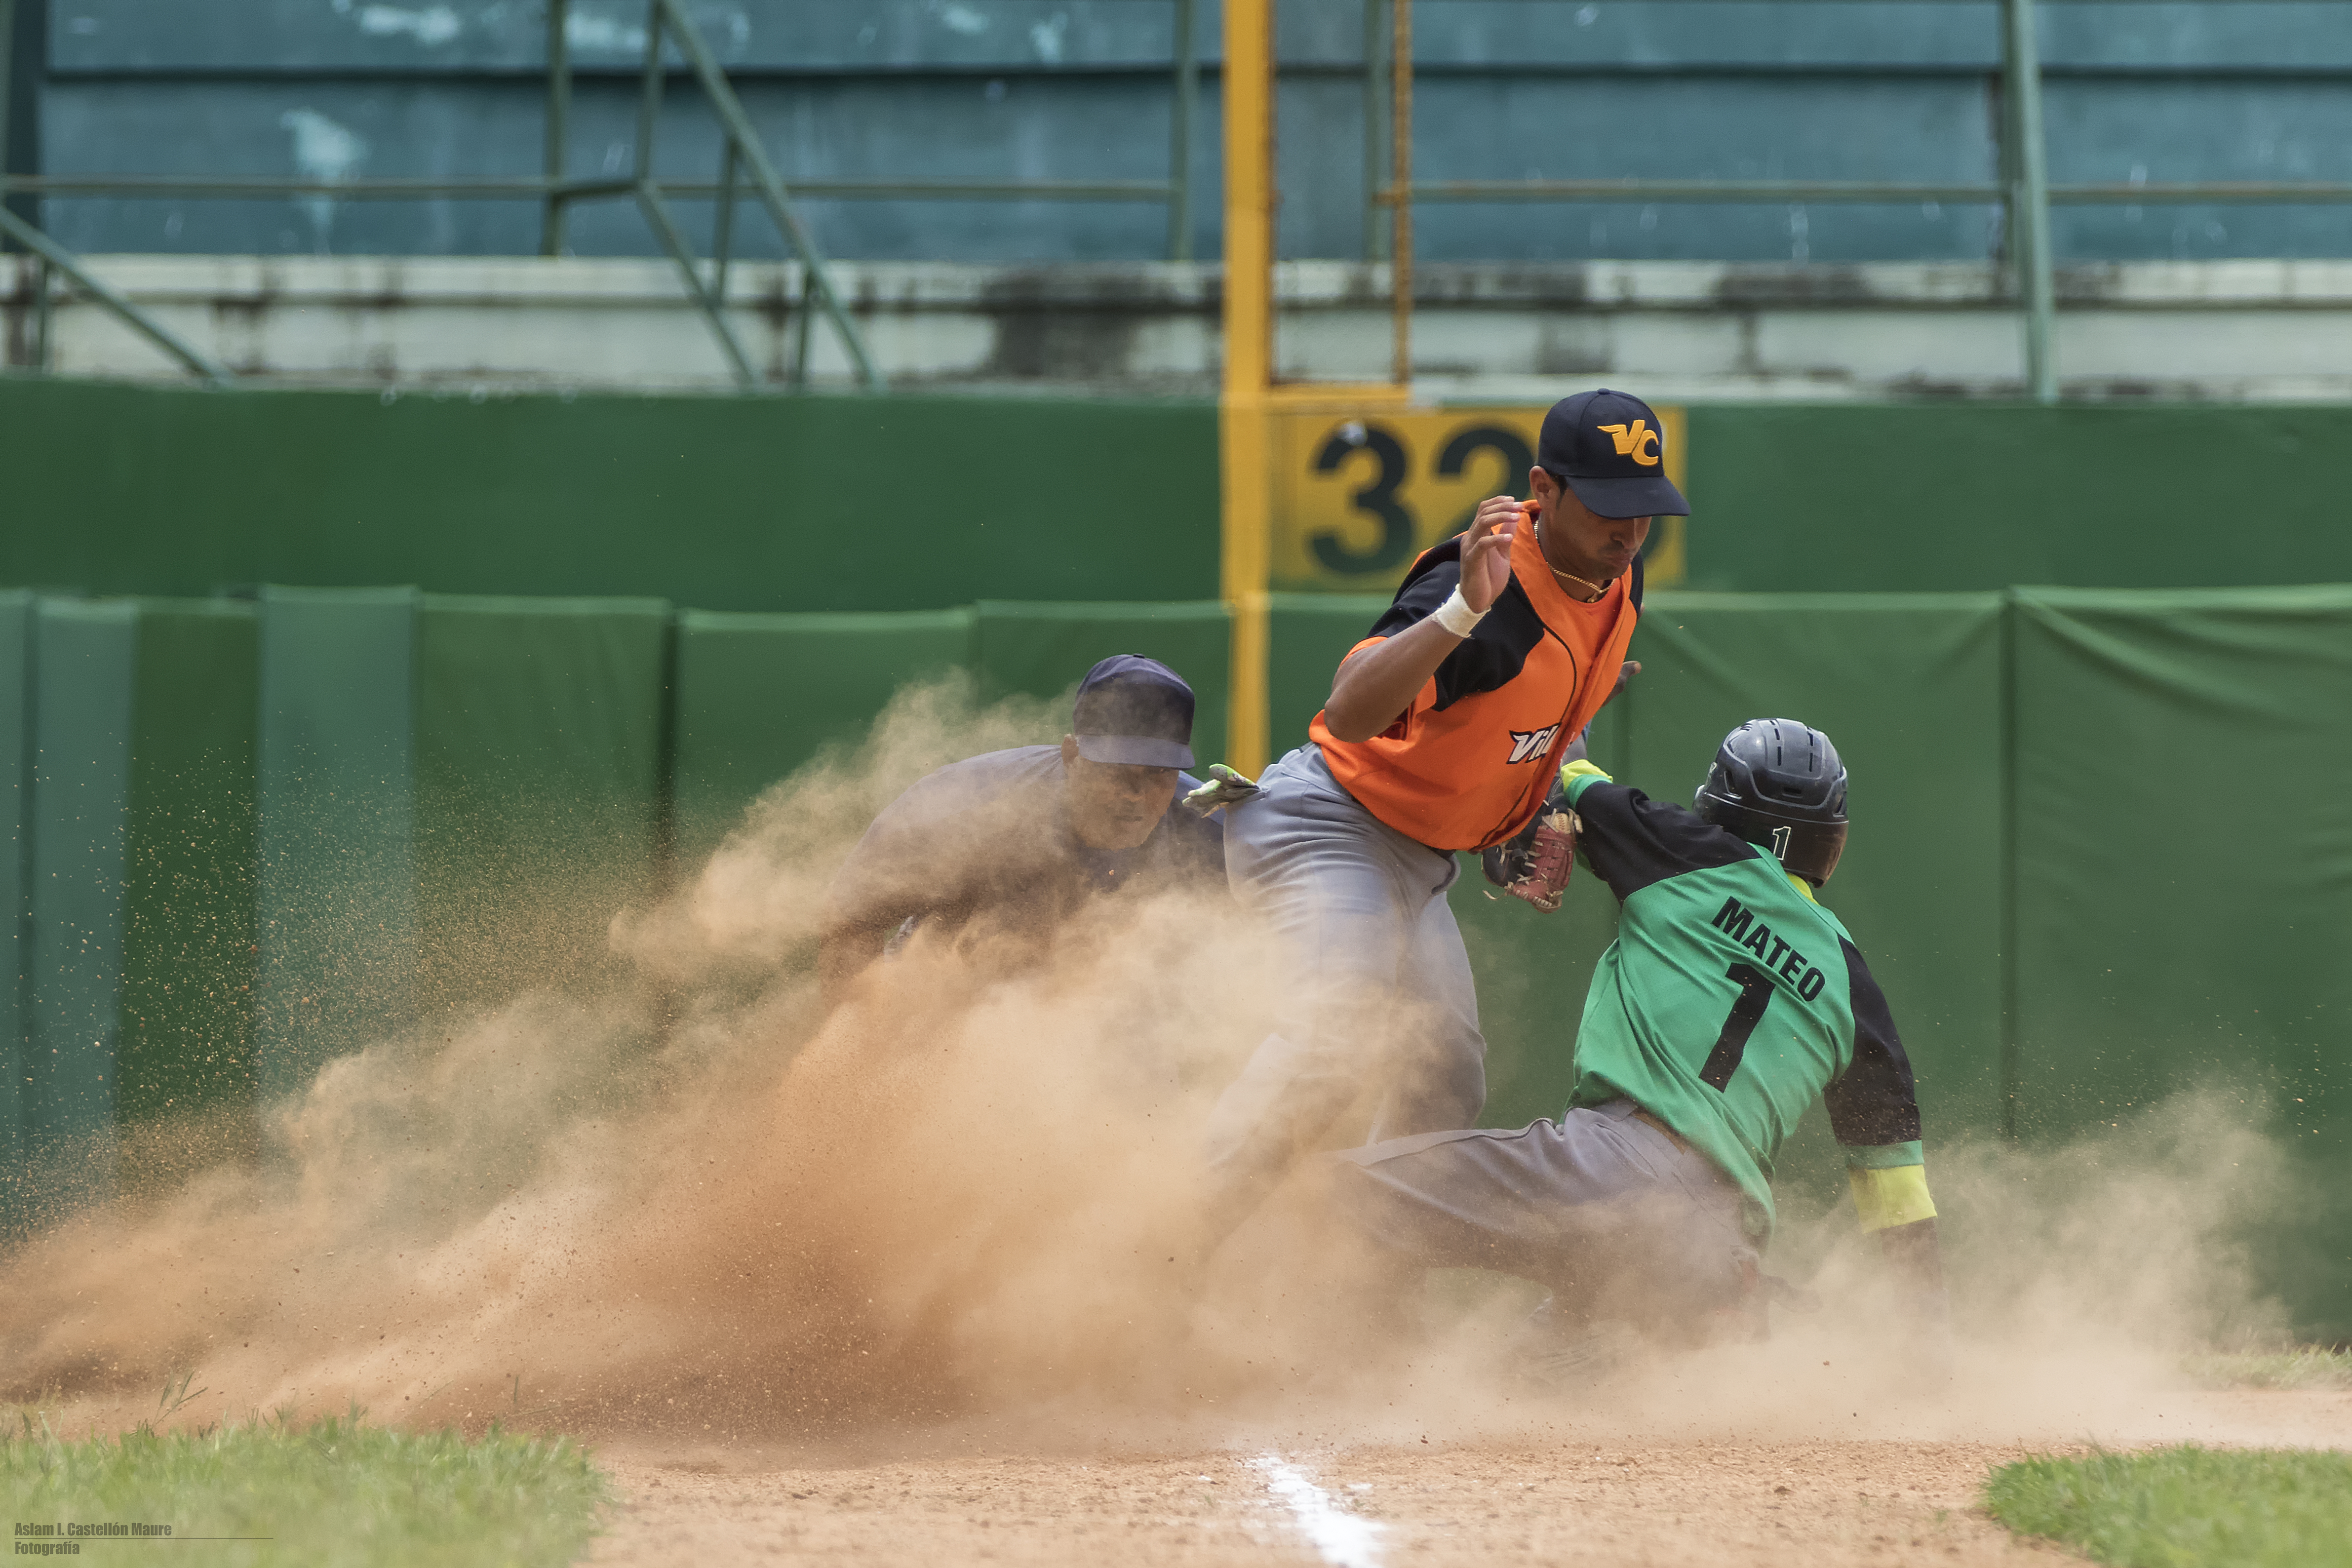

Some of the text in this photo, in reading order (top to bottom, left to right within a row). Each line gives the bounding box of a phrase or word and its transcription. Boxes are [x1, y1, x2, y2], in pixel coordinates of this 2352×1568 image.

[1597, 420, 1659, 466] VC
[1311, 418, 1664, 574] 32
[1772, 826, 1792, 861] 1
[1711, 896, 1826, 1002] MATEO
